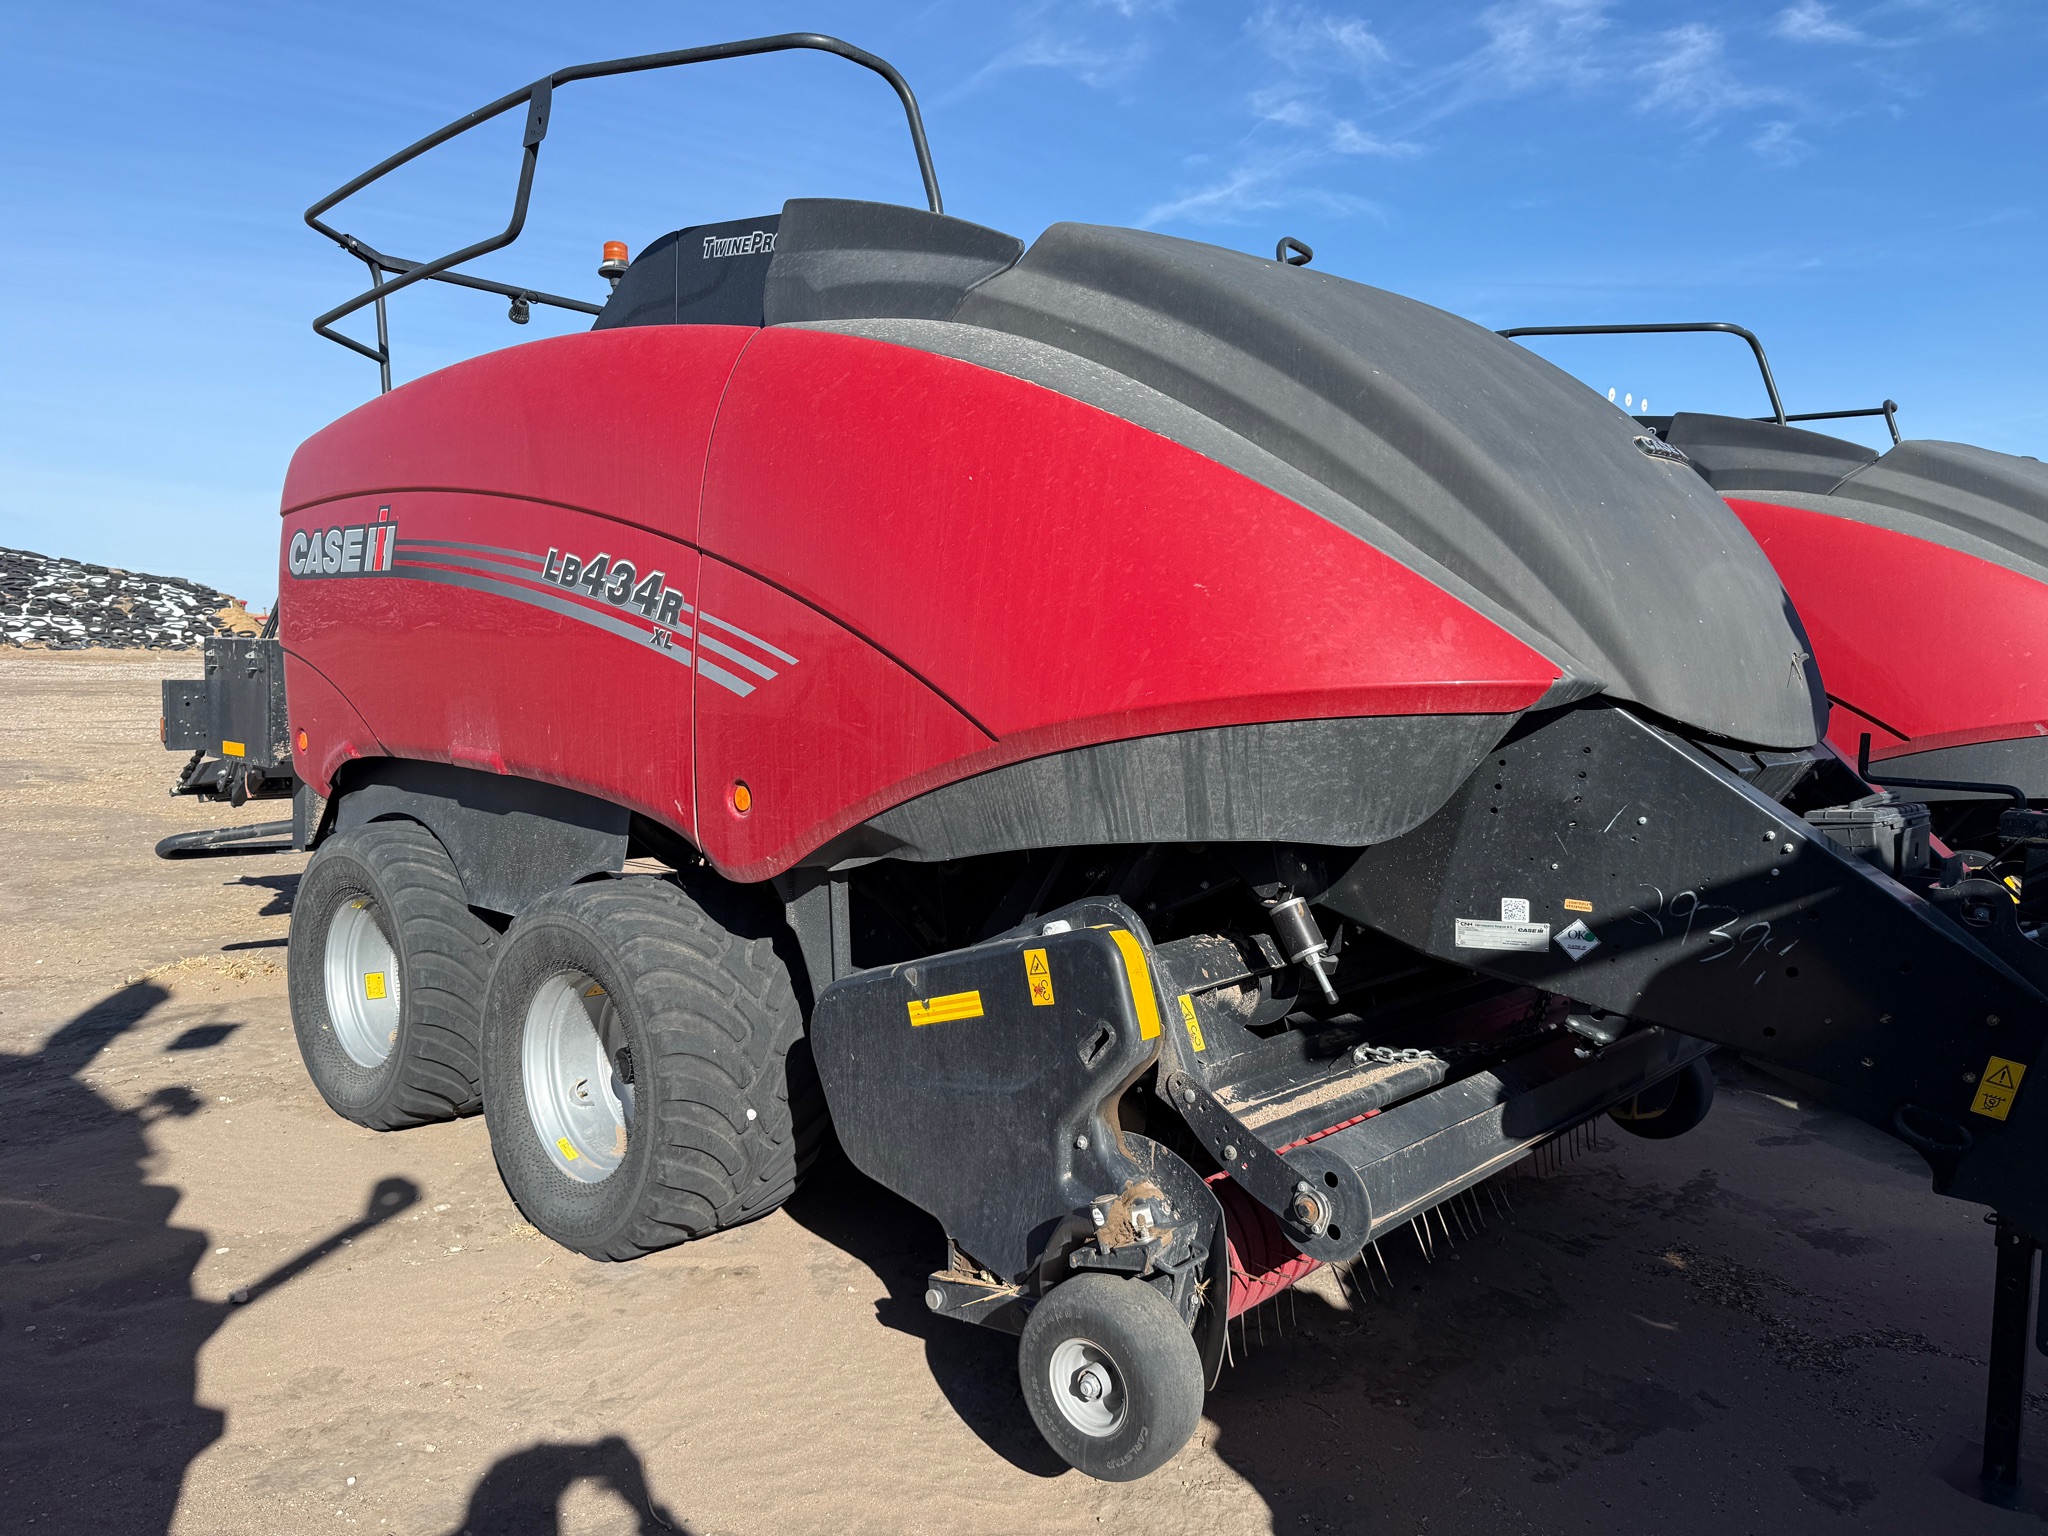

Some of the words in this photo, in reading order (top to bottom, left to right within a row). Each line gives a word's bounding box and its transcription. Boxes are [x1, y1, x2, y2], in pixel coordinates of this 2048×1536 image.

[289, 527, 365, 577] CASE
[541, 546, 685, 628] LB434R
[649, 626, 673, 650] XL
[1568, 930, 1587, 940] OK
[1106, 1426, 1149, 1470] CARLSTAR
